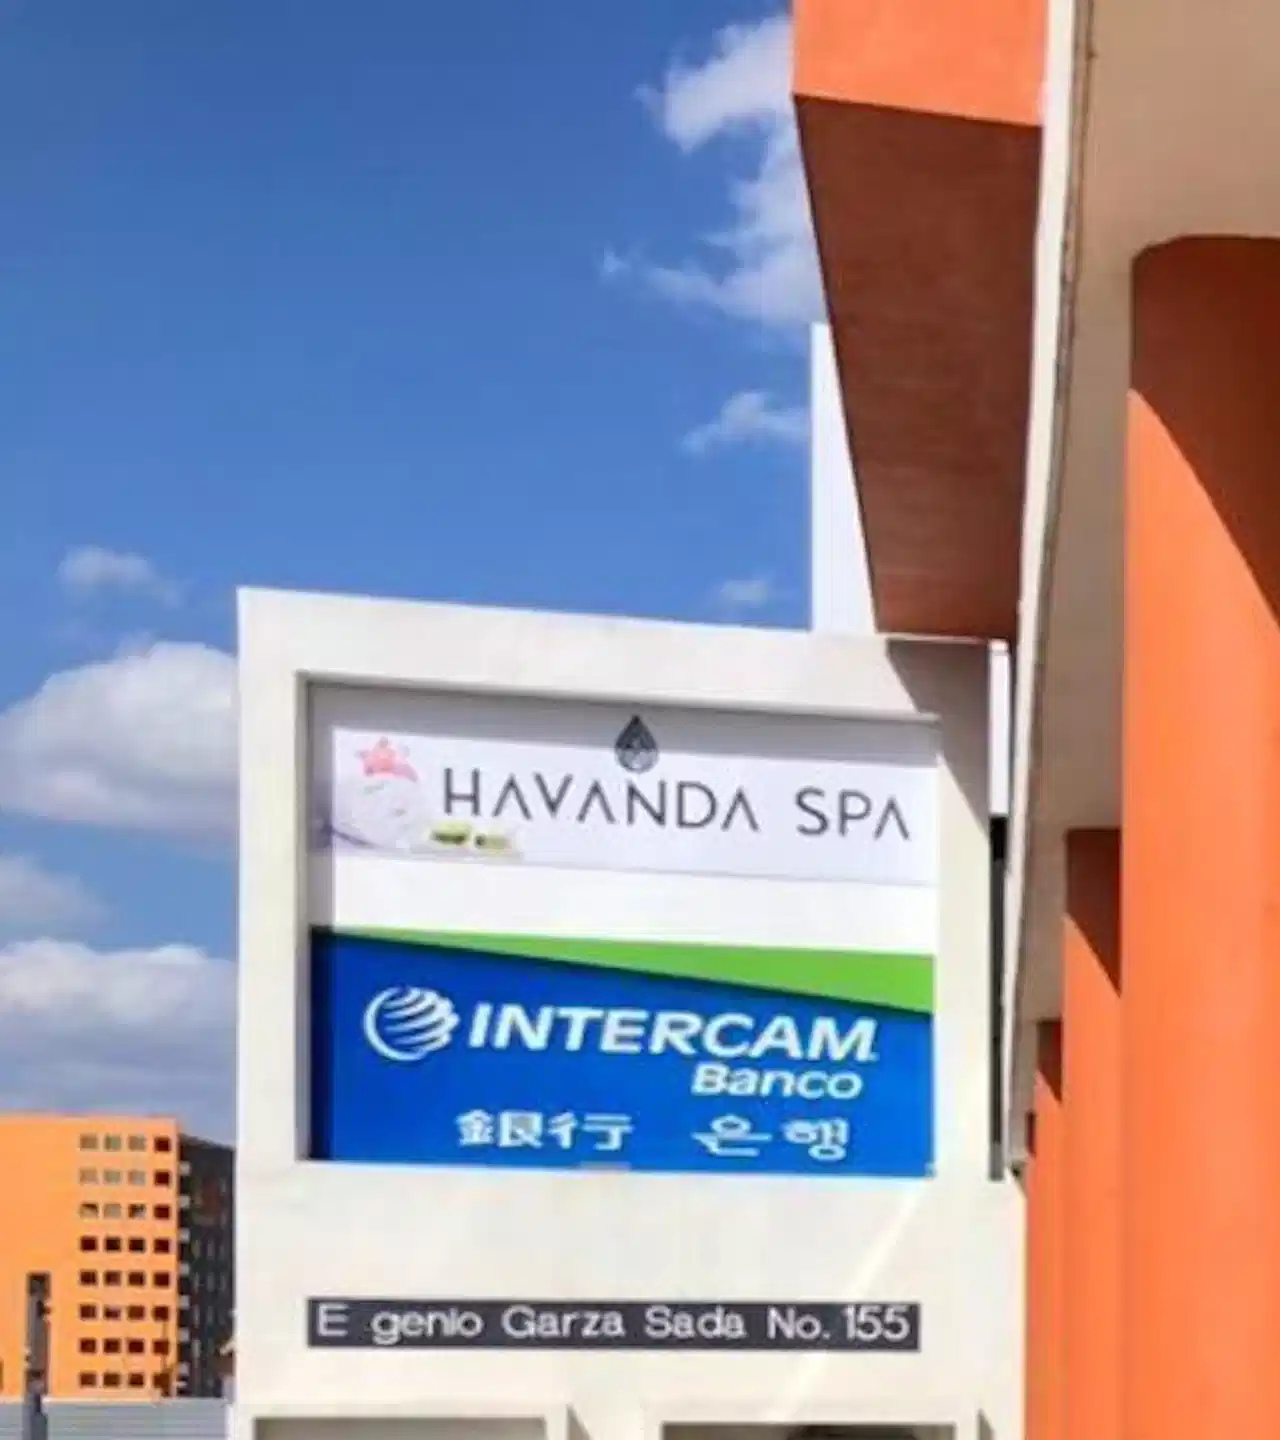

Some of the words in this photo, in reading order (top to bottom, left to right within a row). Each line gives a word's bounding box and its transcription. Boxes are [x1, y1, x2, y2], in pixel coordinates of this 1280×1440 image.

[442, 766, 761, 834] HAVANDA
[795, 786, 912, 842] SPA
[467, 1002, 880, 1063] INTERCAM
[690, 1061, 864, 1101] Banco
[455, 1108, 635, 1152] 銀行
[500, 1304, 627, 1340] Garza
[643, 1305, 748, 1340] Sada
[766, 1307, 832, 1342] No.
[844, 1304, 912, 1342] 155
